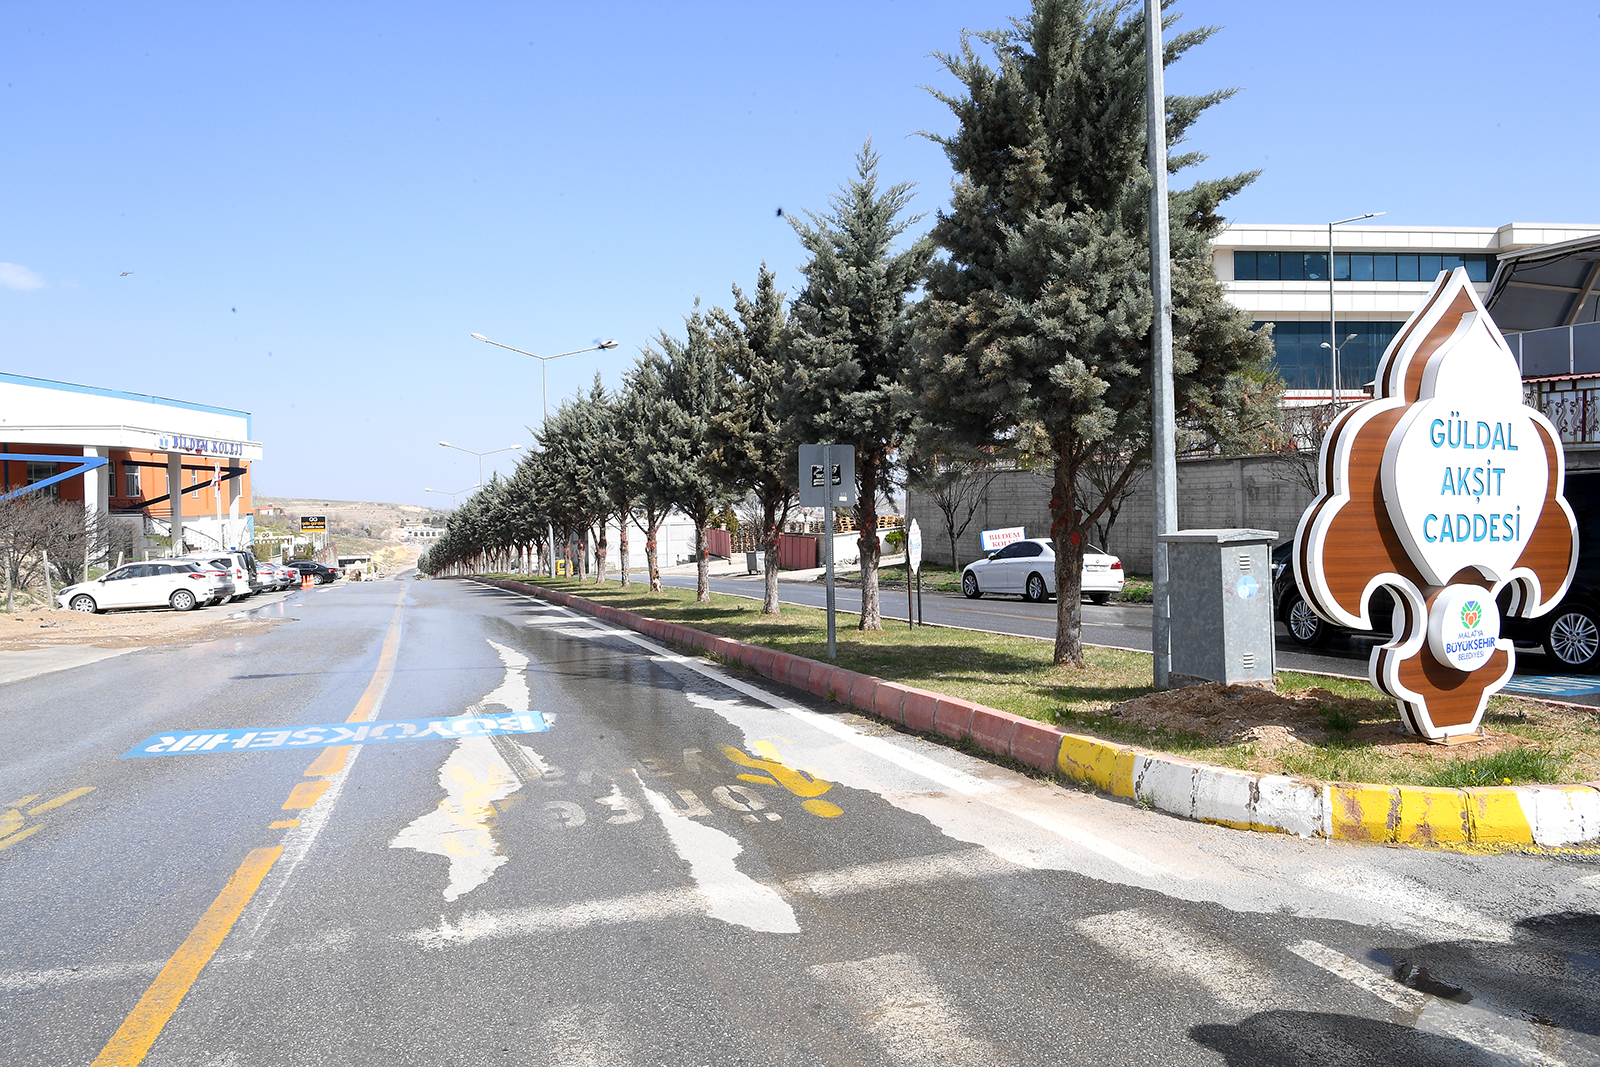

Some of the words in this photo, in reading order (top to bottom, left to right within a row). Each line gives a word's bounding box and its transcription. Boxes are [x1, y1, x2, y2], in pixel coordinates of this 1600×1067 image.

[172, 434, 209, 451] BİLDEM
[211, 440, 243, 456] KOLEJİ
[1429, 411, 1518, 451] GÜLDAL
[1440, 459, 1506, 505] AKŞİT
[1422, 505, 1521, 543] CADDESİ
[1446, 637, 1496, 654] BÜYÜKŞEHİR
[1457, 629, 1484, 639] MALATYA
[1457, 651, 1485, 661] BELEDİYESİ
[144, 713, 536, 753] BÜYÜKŞEHİR
